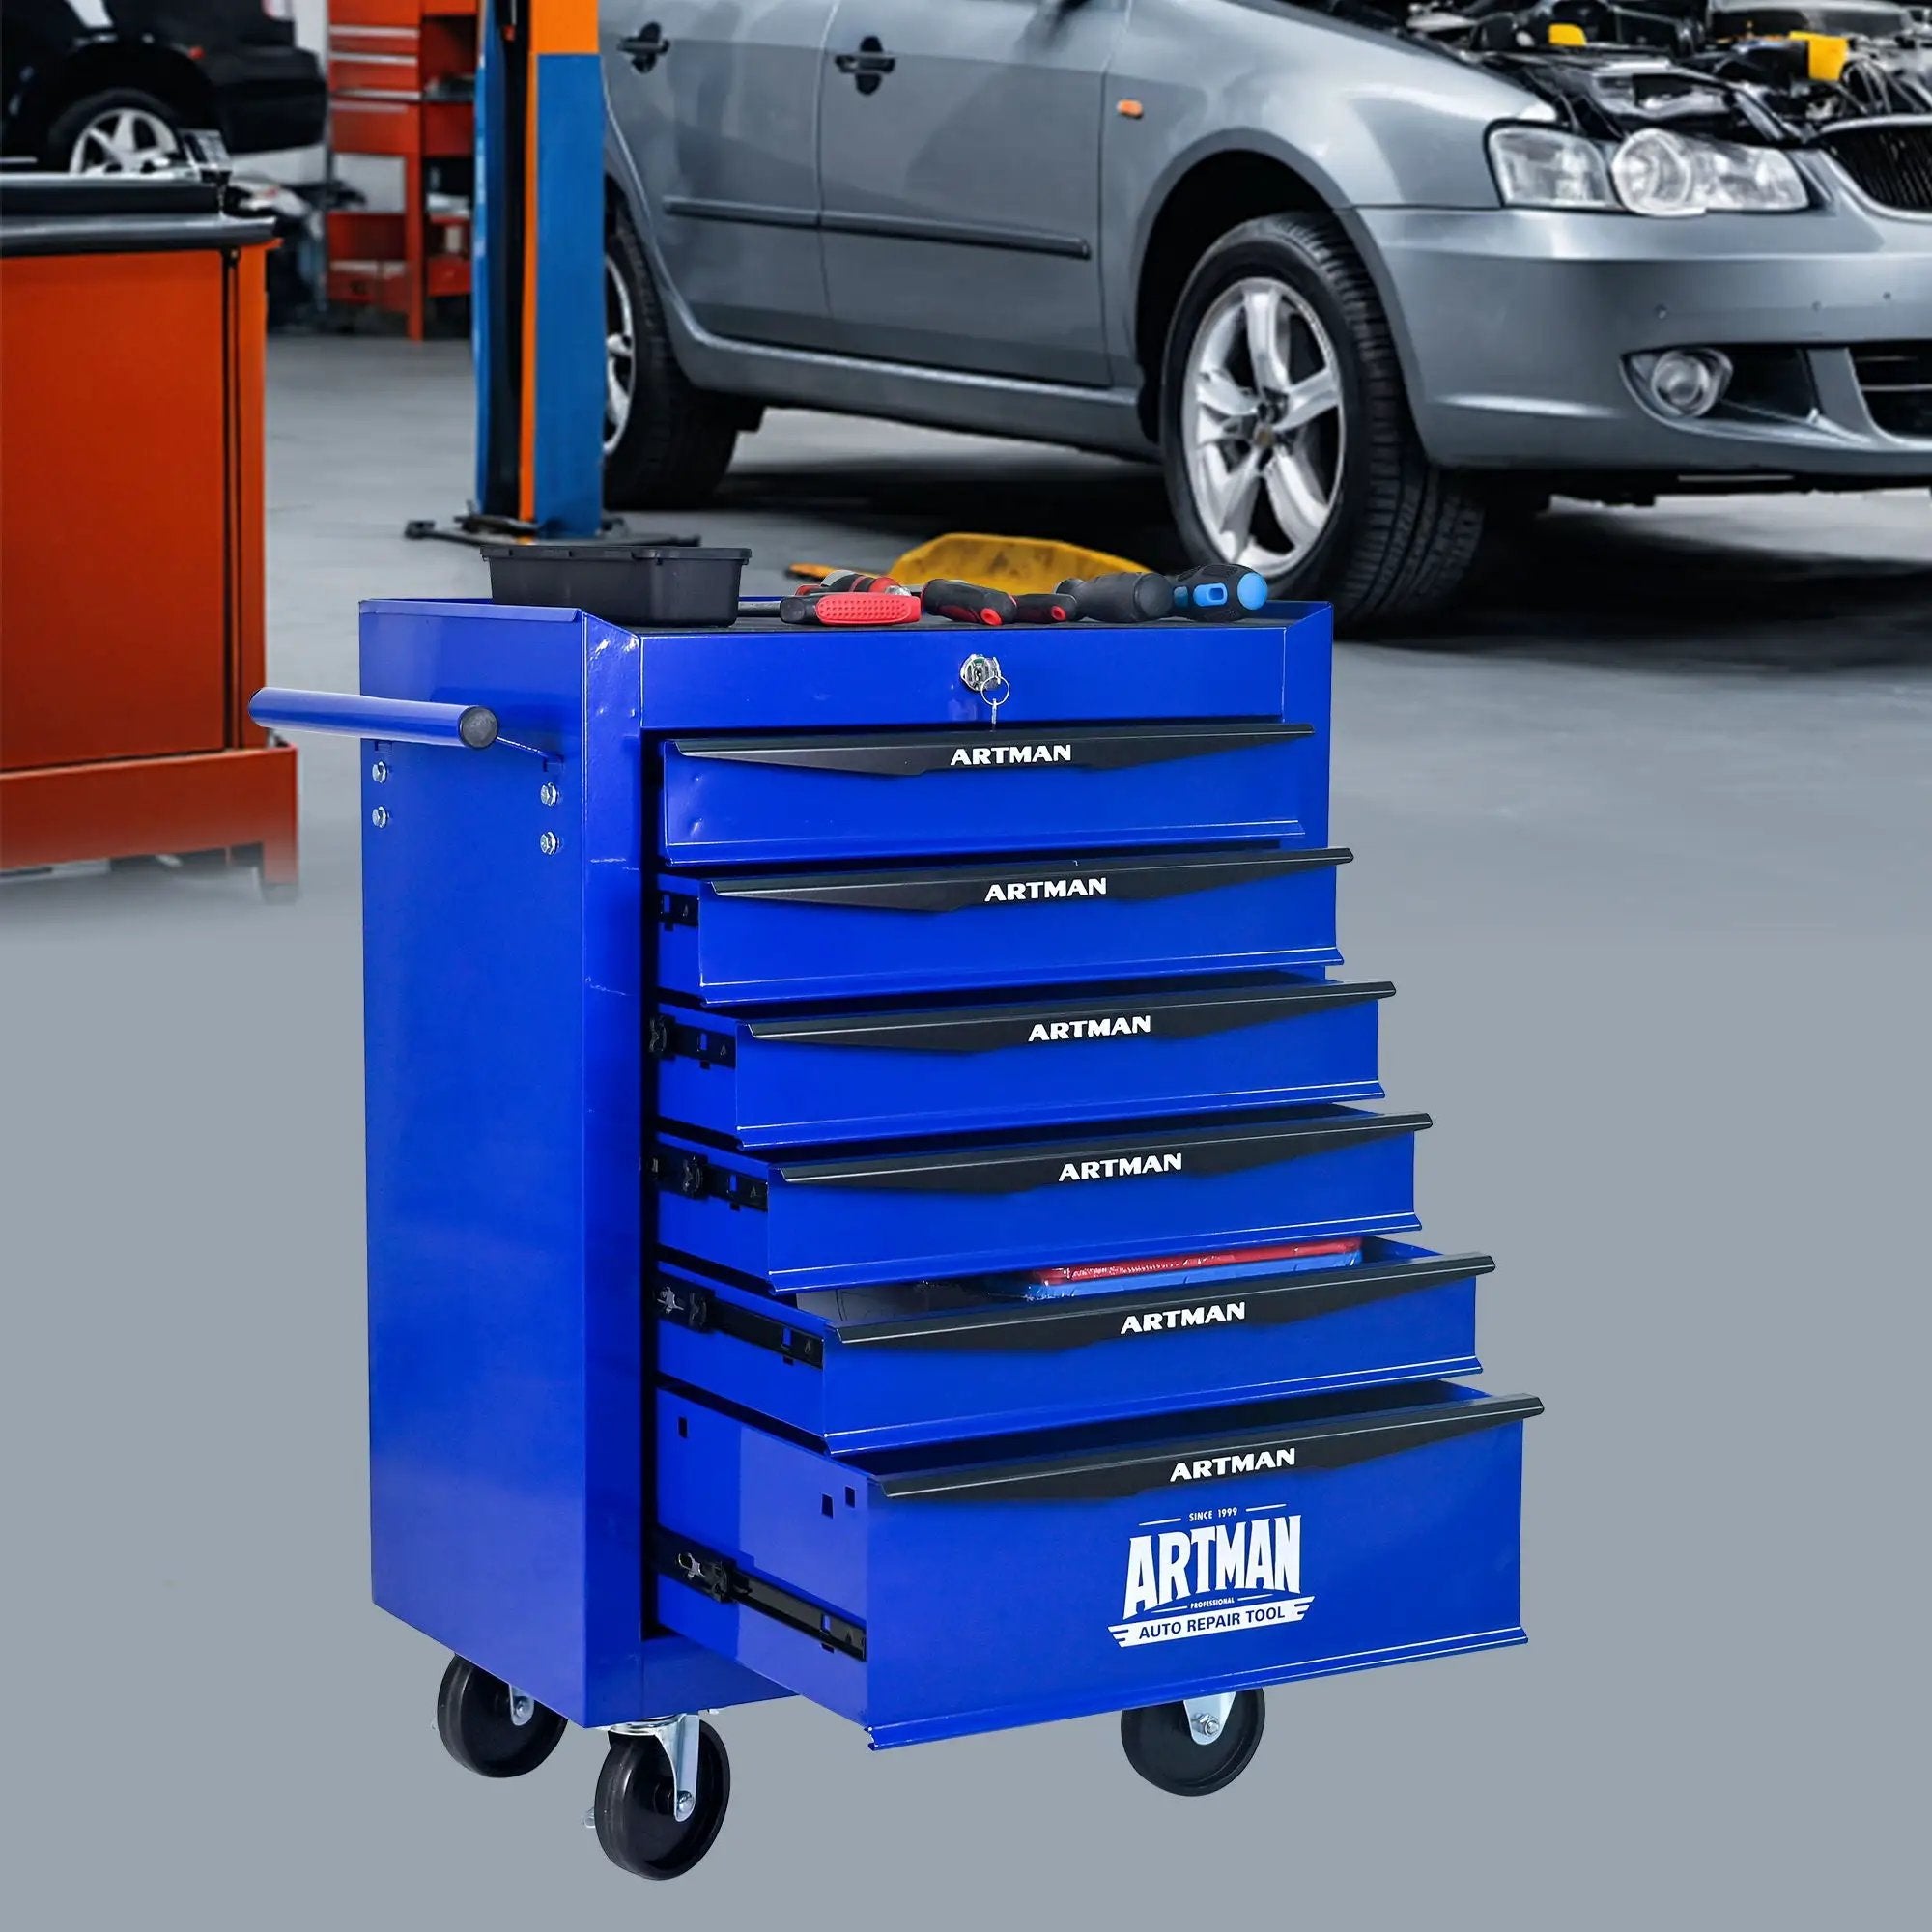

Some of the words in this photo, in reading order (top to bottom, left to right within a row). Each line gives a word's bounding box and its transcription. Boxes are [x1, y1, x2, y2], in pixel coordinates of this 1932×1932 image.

[950, 744, 1071, 766] ARTMAN
[984, 877, 1107, 902] ARTMAN
[1028, 1015, 1151, 1042] ARTMAN
[1058, 1152, 1182, 1182] ARTMAN
[1120, 1301, 1245, 1335] ARTMAN
[1169, 1447, 1295, 1483] ARTMAN
[1188, 1510, 1213, 1522] SINCE
[1217, 1507, 1238, 1519] 1999
[1122, 1514, 1302, 1620] ARTMAN
[1190, 1597, 1235, 1609] PROFESSIONAL
[1138, 1621, 1182, 1640] AUTO
[1186, 1612, 1241, 1633] REPAIR
[1245, 1605, 1286, 1623] TOOL
